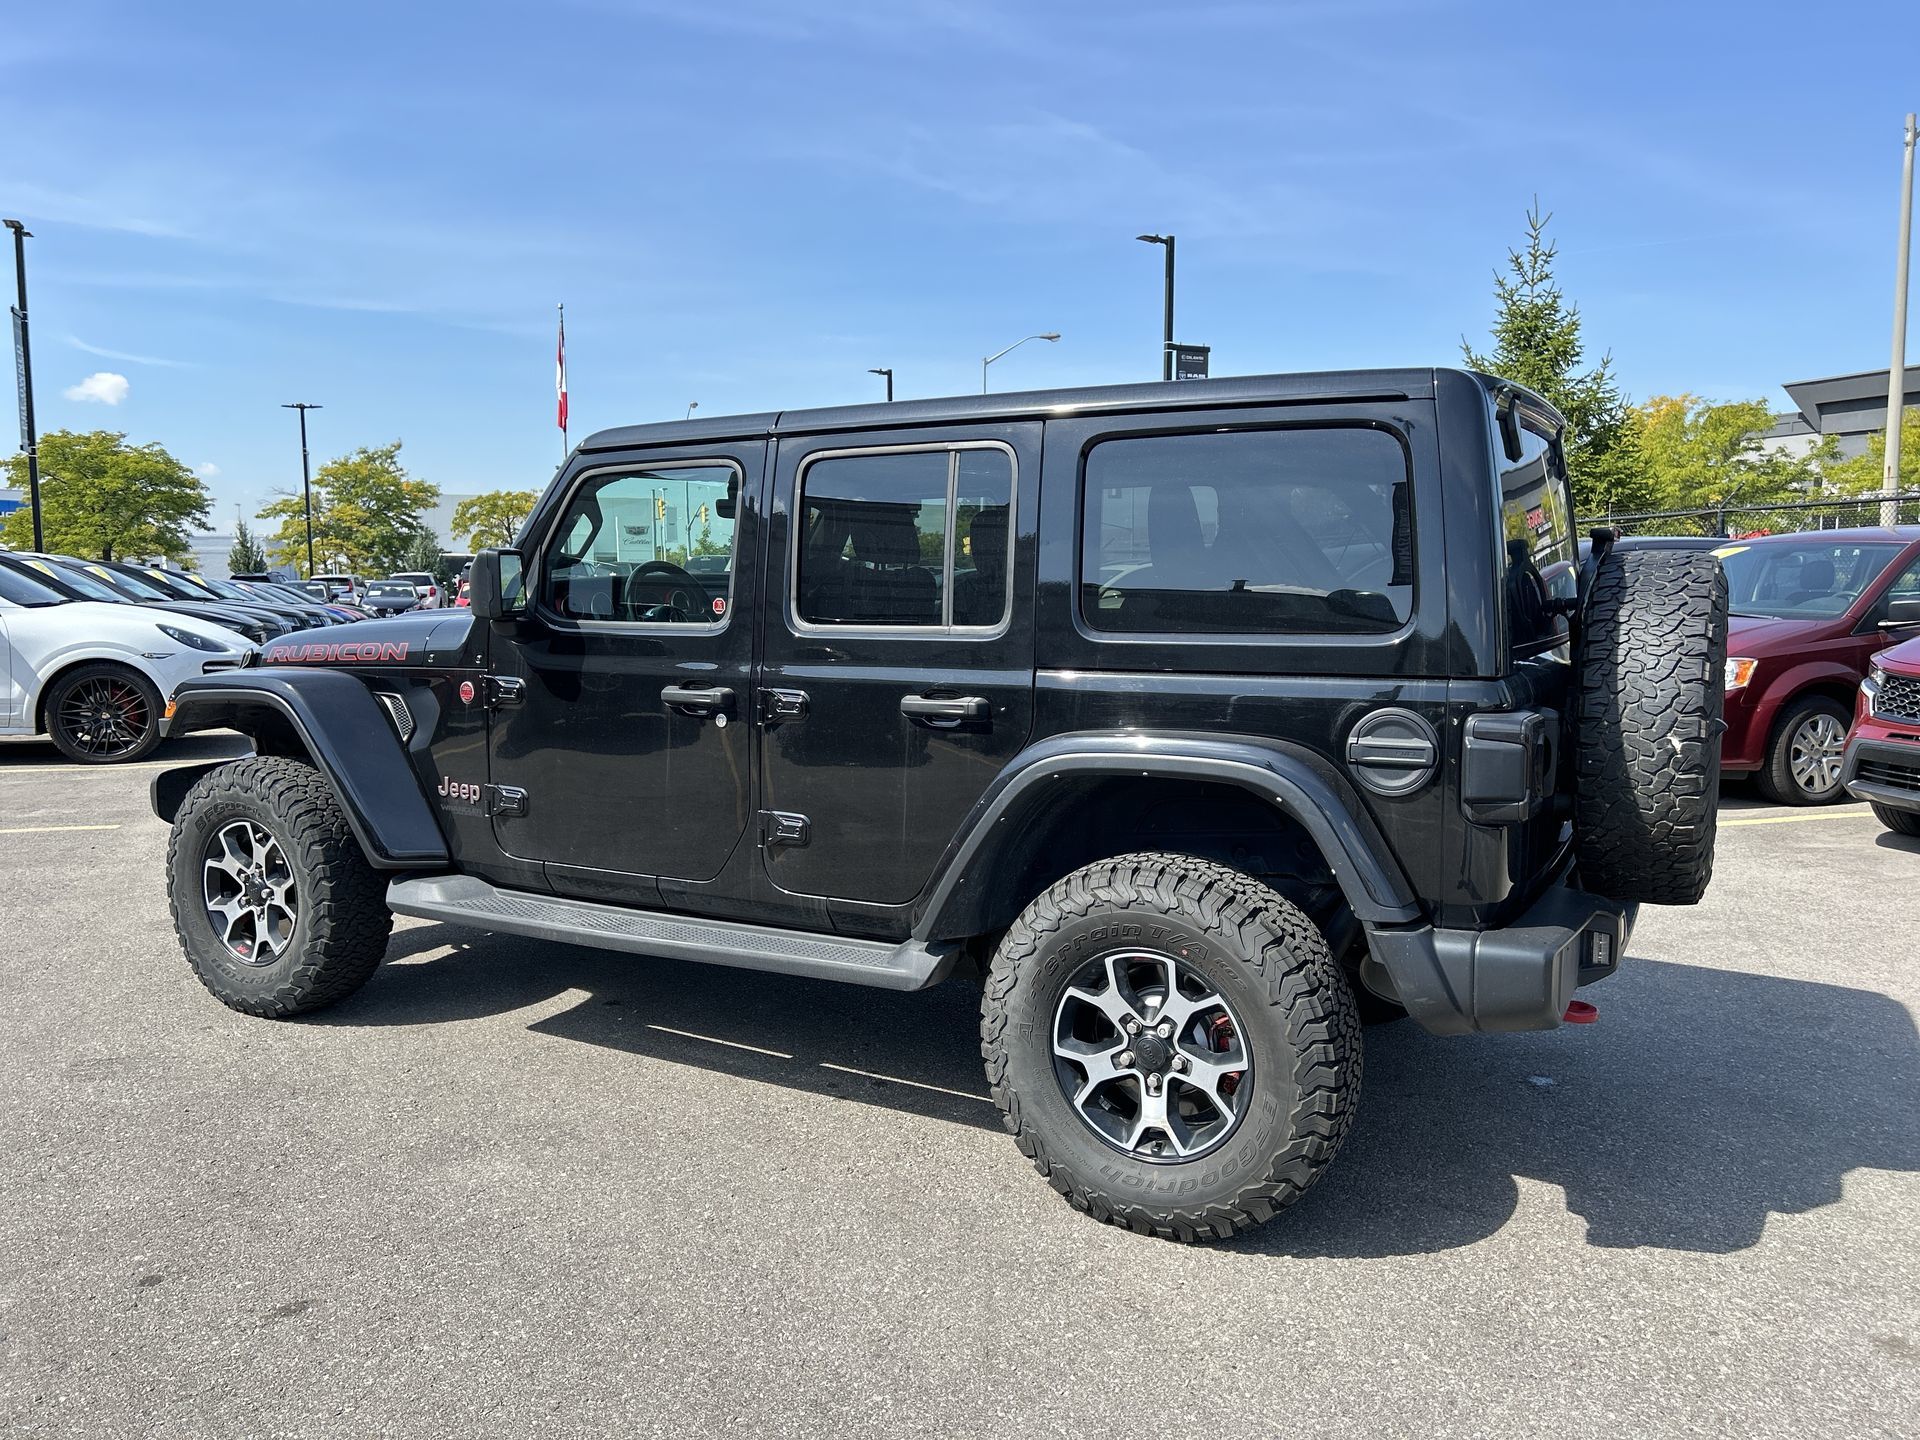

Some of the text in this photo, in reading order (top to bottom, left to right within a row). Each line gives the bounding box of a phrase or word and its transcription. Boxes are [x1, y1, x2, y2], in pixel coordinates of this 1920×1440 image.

[267, 642, 409, 663] RUBICON
[438, 776, 480, 804] Jeep
[1100, 1092, 1278, 1196] BFGoodrich
